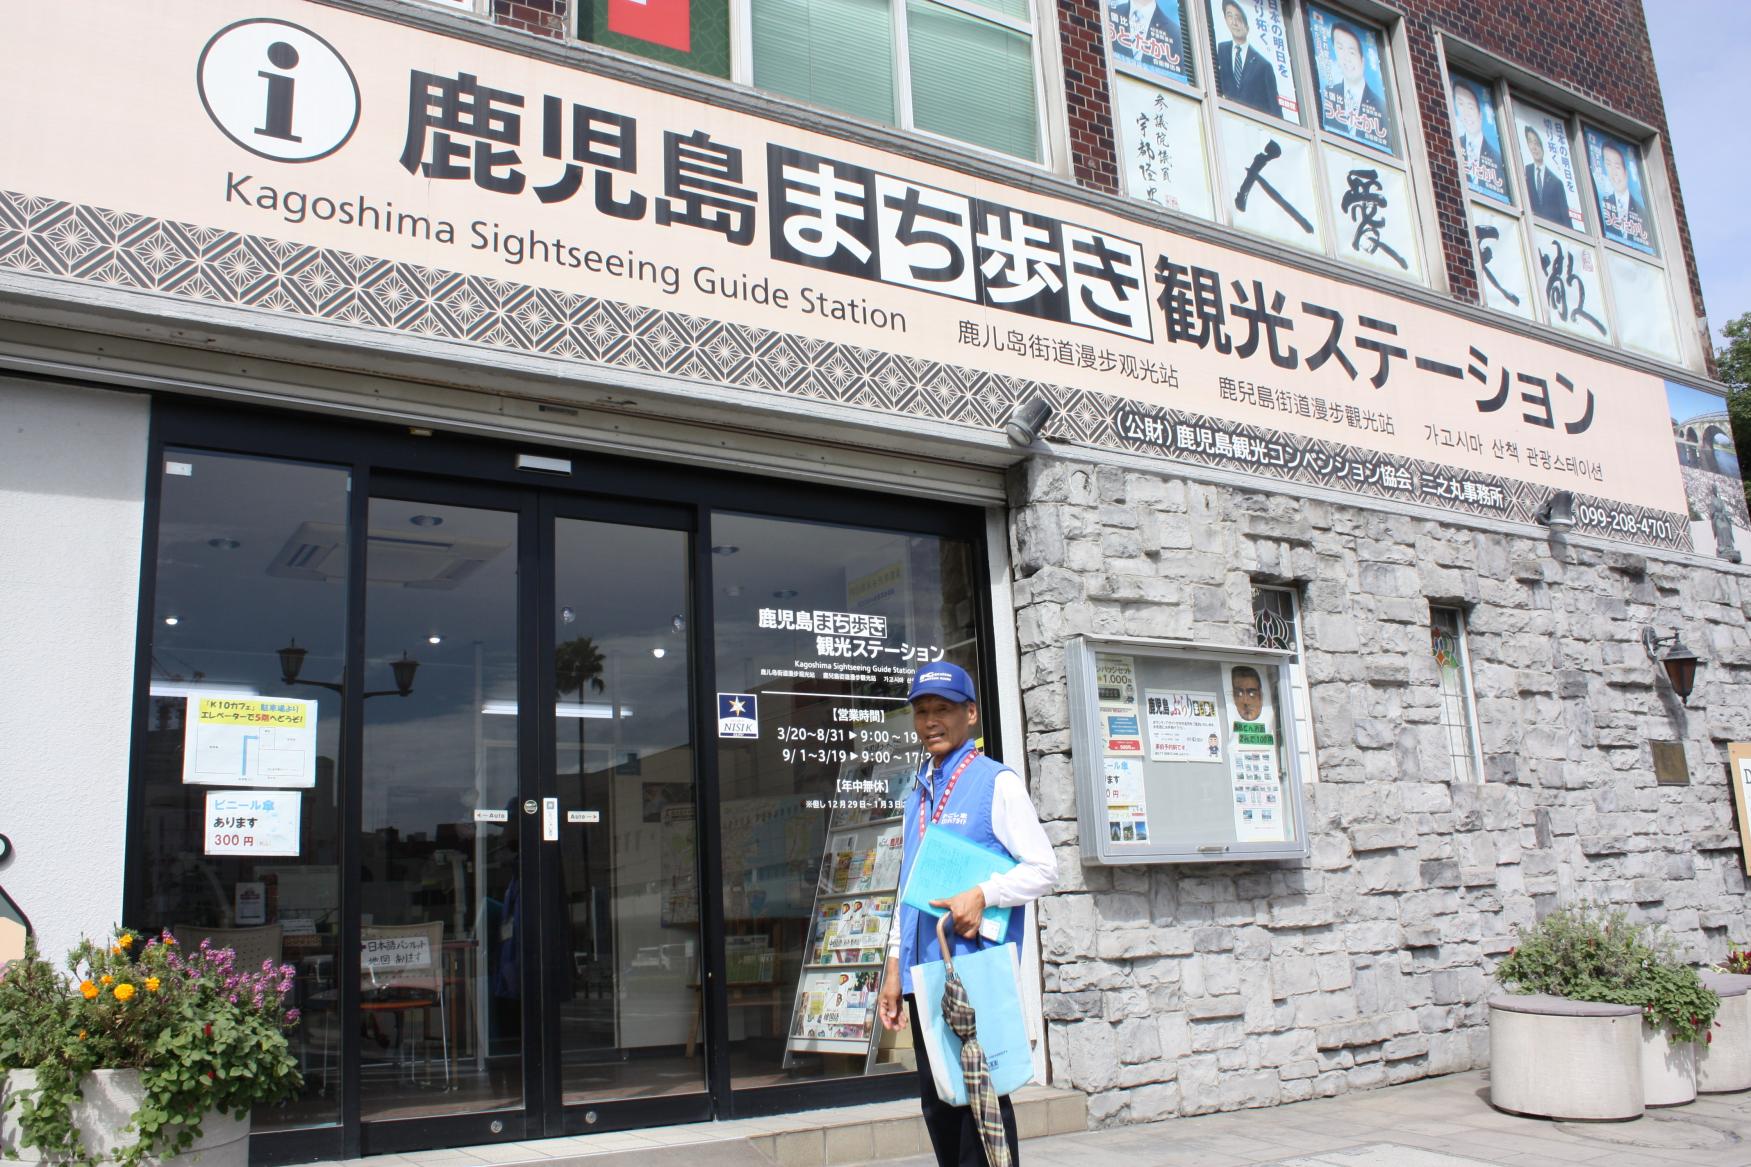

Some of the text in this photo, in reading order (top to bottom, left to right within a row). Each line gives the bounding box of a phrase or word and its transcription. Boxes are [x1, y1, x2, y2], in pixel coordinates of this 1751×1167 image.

[225, 171, 908, 334] Kagoshima Sightseeing Guide Station
[957, 319, 1180, 390] 鹿儿岛街道漫步观光站
[1423, 423, 1604, 482] 가고시마 산책 관광스테이션
[1579, 505, 1673, 540] 099-208-4701
[758, 607, 888, 638] 鹿児島まち歩き
[815, 635, 946, 663] 観光ステーション
[794, 660, 916, 675] Kagoshima Sightseeing Guide Station
[214, 799, 275, 811] ビニール傘
[213, 816, 258, 829] あります
[214, 834, 240, 846] 300
